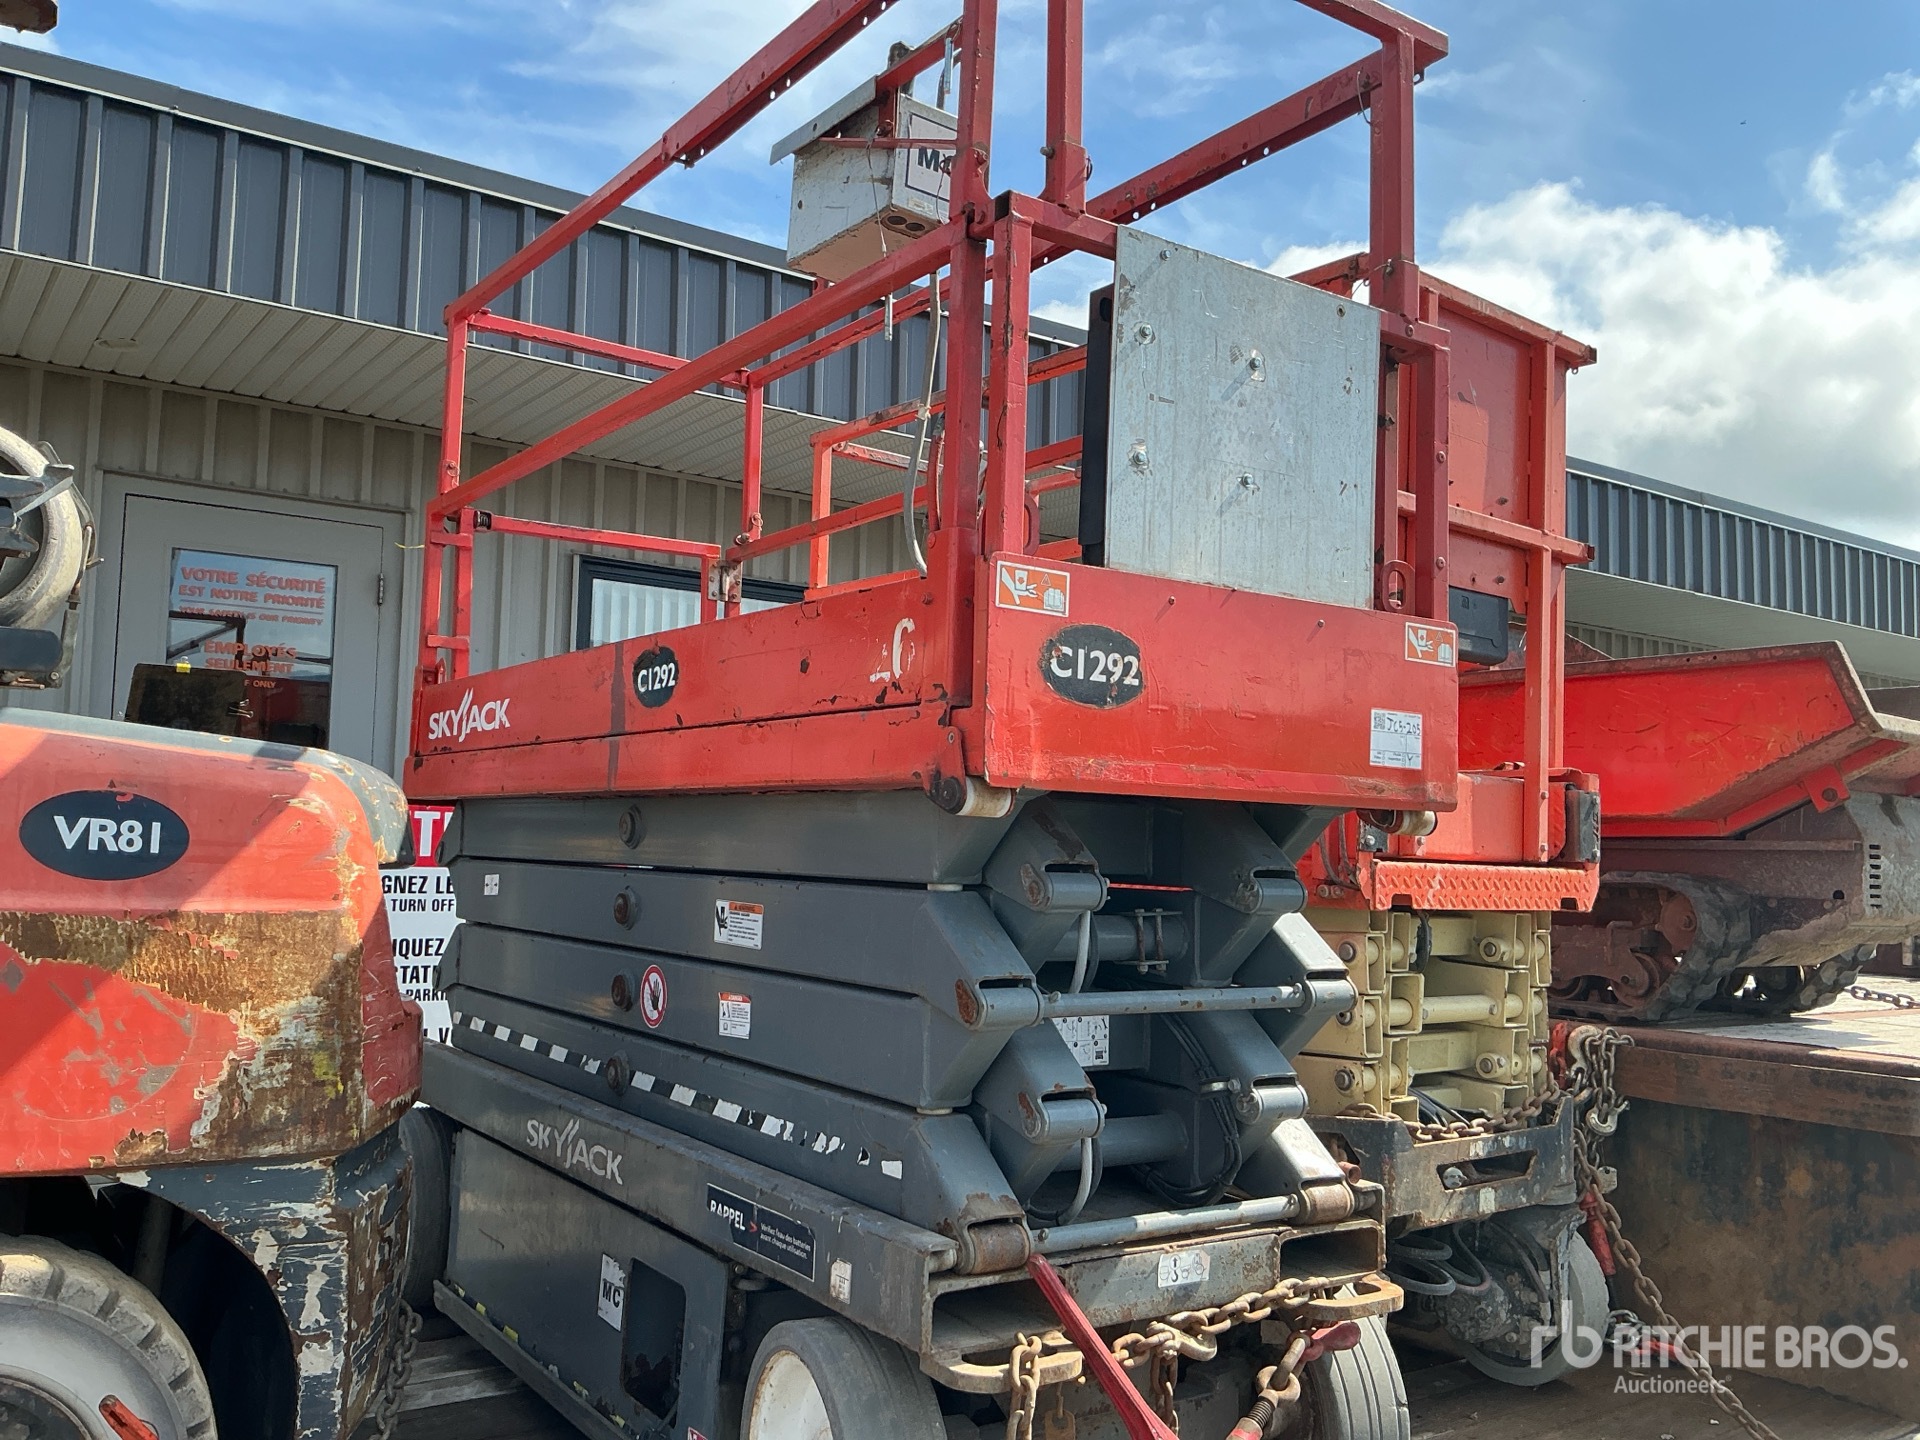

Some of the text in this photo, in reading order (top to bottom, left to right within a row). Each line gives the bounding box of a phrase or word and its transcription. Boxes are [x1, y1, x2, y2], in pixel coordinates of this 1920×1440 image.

[180, 566, 326, 594] VOTRE SÉCURITÉ
[178, 584, 325, 609] EST NOTRE PRIORITÉ
[258, 613, 279, 622] OUR
[281, 615, 324, 626] PRIORITY
[204, 640, 297, 659] EMPLOYÉS
[205, 657, 294, 673] SEULEMENT
[252, 679, 276, 689] ONLY
[428, 688, 511, 743] SKYJACK
[53, 815, 161, 854] VR81
[381, 875, 428, 894] GNEZ
[391, 898, 455, 912] TURN OFF
[392, 938, 445, 959] IQUEZ
[526, 1118, 623, 1185] SKYJACK
[710, 1199, 746, 1231] RAPPEL
[602, 1280, 621, 1308] MC
